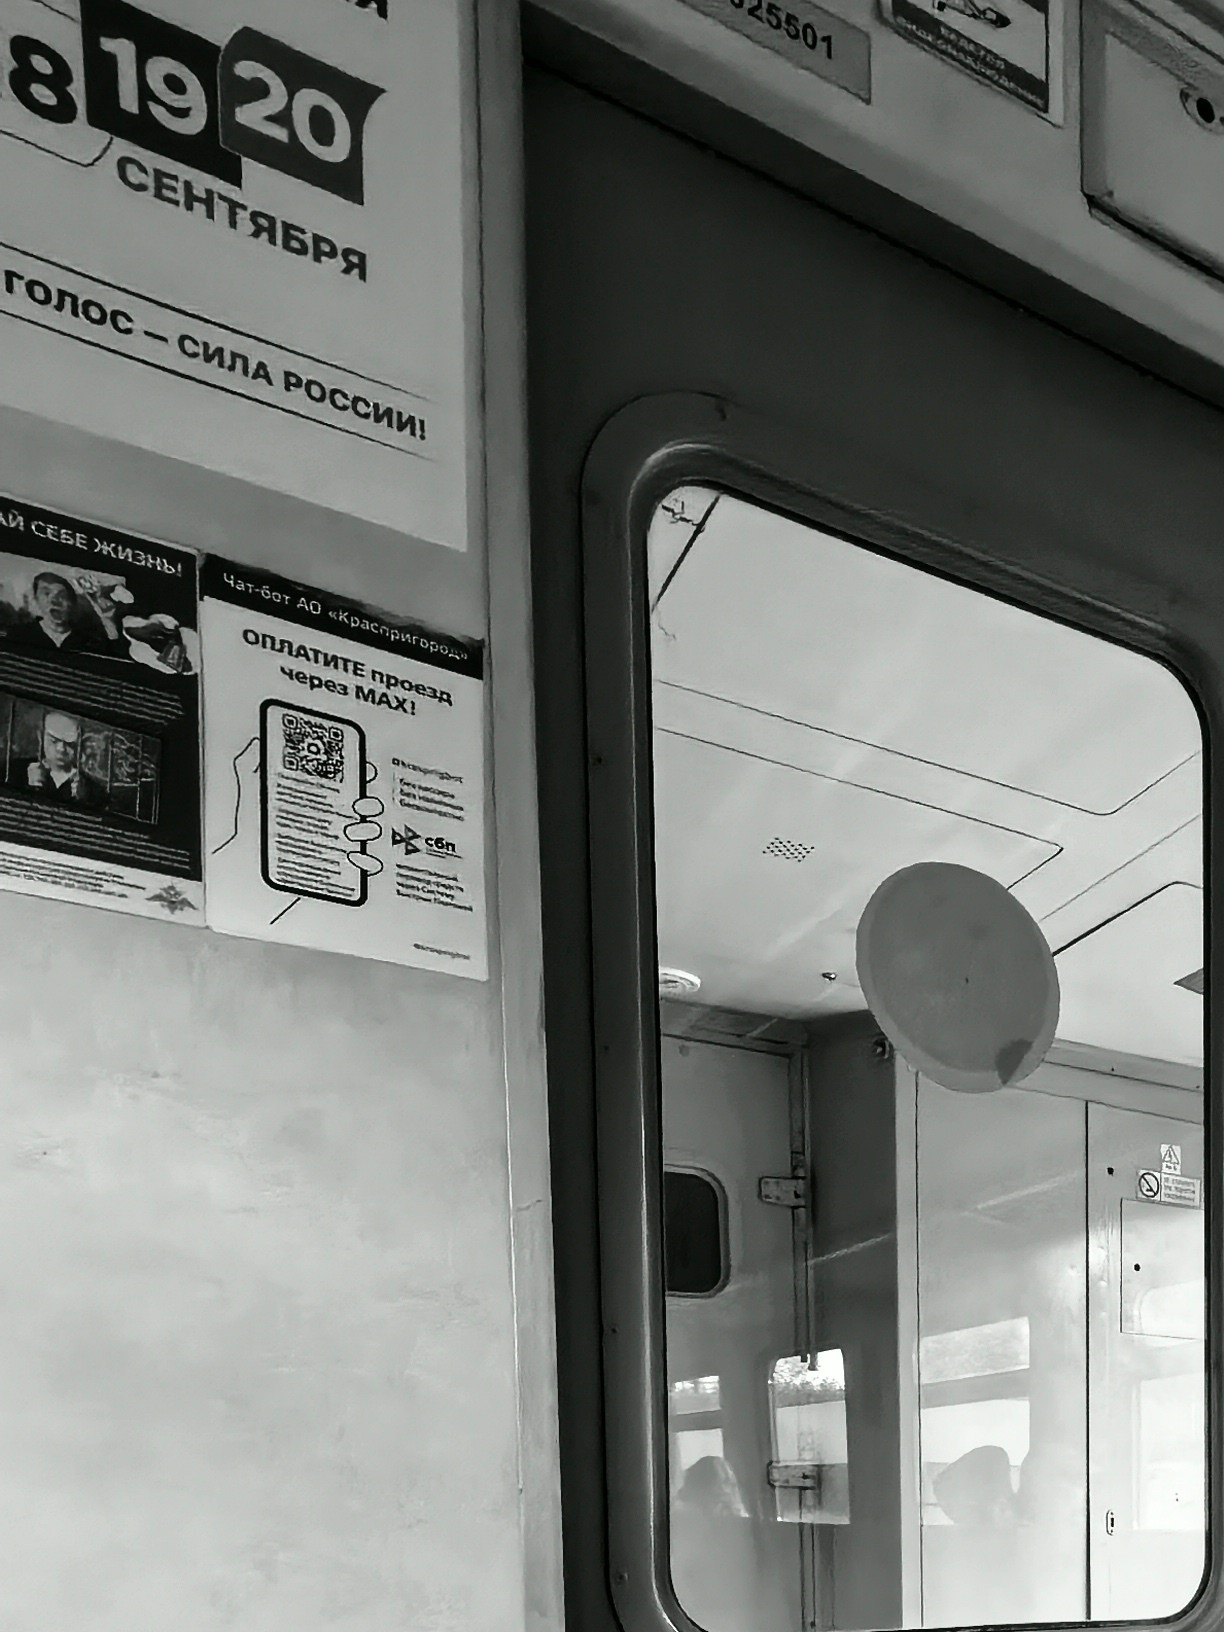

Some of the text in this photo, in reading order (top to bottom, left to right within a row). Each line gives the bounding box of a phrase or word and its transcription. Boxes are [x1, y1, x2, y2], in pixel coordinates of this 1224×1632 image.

[100, 37, 208, 136] 19
[233, 60, 351, 163] 20
[116, 155, 368, 282] СЕНТЯБРЯ
[3, 269, 133, 336] ГОЛОС
[178, 333, 273, 386] СИЛА
[283, 370, 427, 440] РОССИИ!
[31, 520, 88, 550] СЕБЕ
[93, 537, 182, 577] ЖИЗНЬ!
[223, 572, 468, 661] Чат-бот АО «Краспригород»
[242, 628, 453, 707] ОПЛАТИТЕ проезд
[280, 665, 349, 696] через
